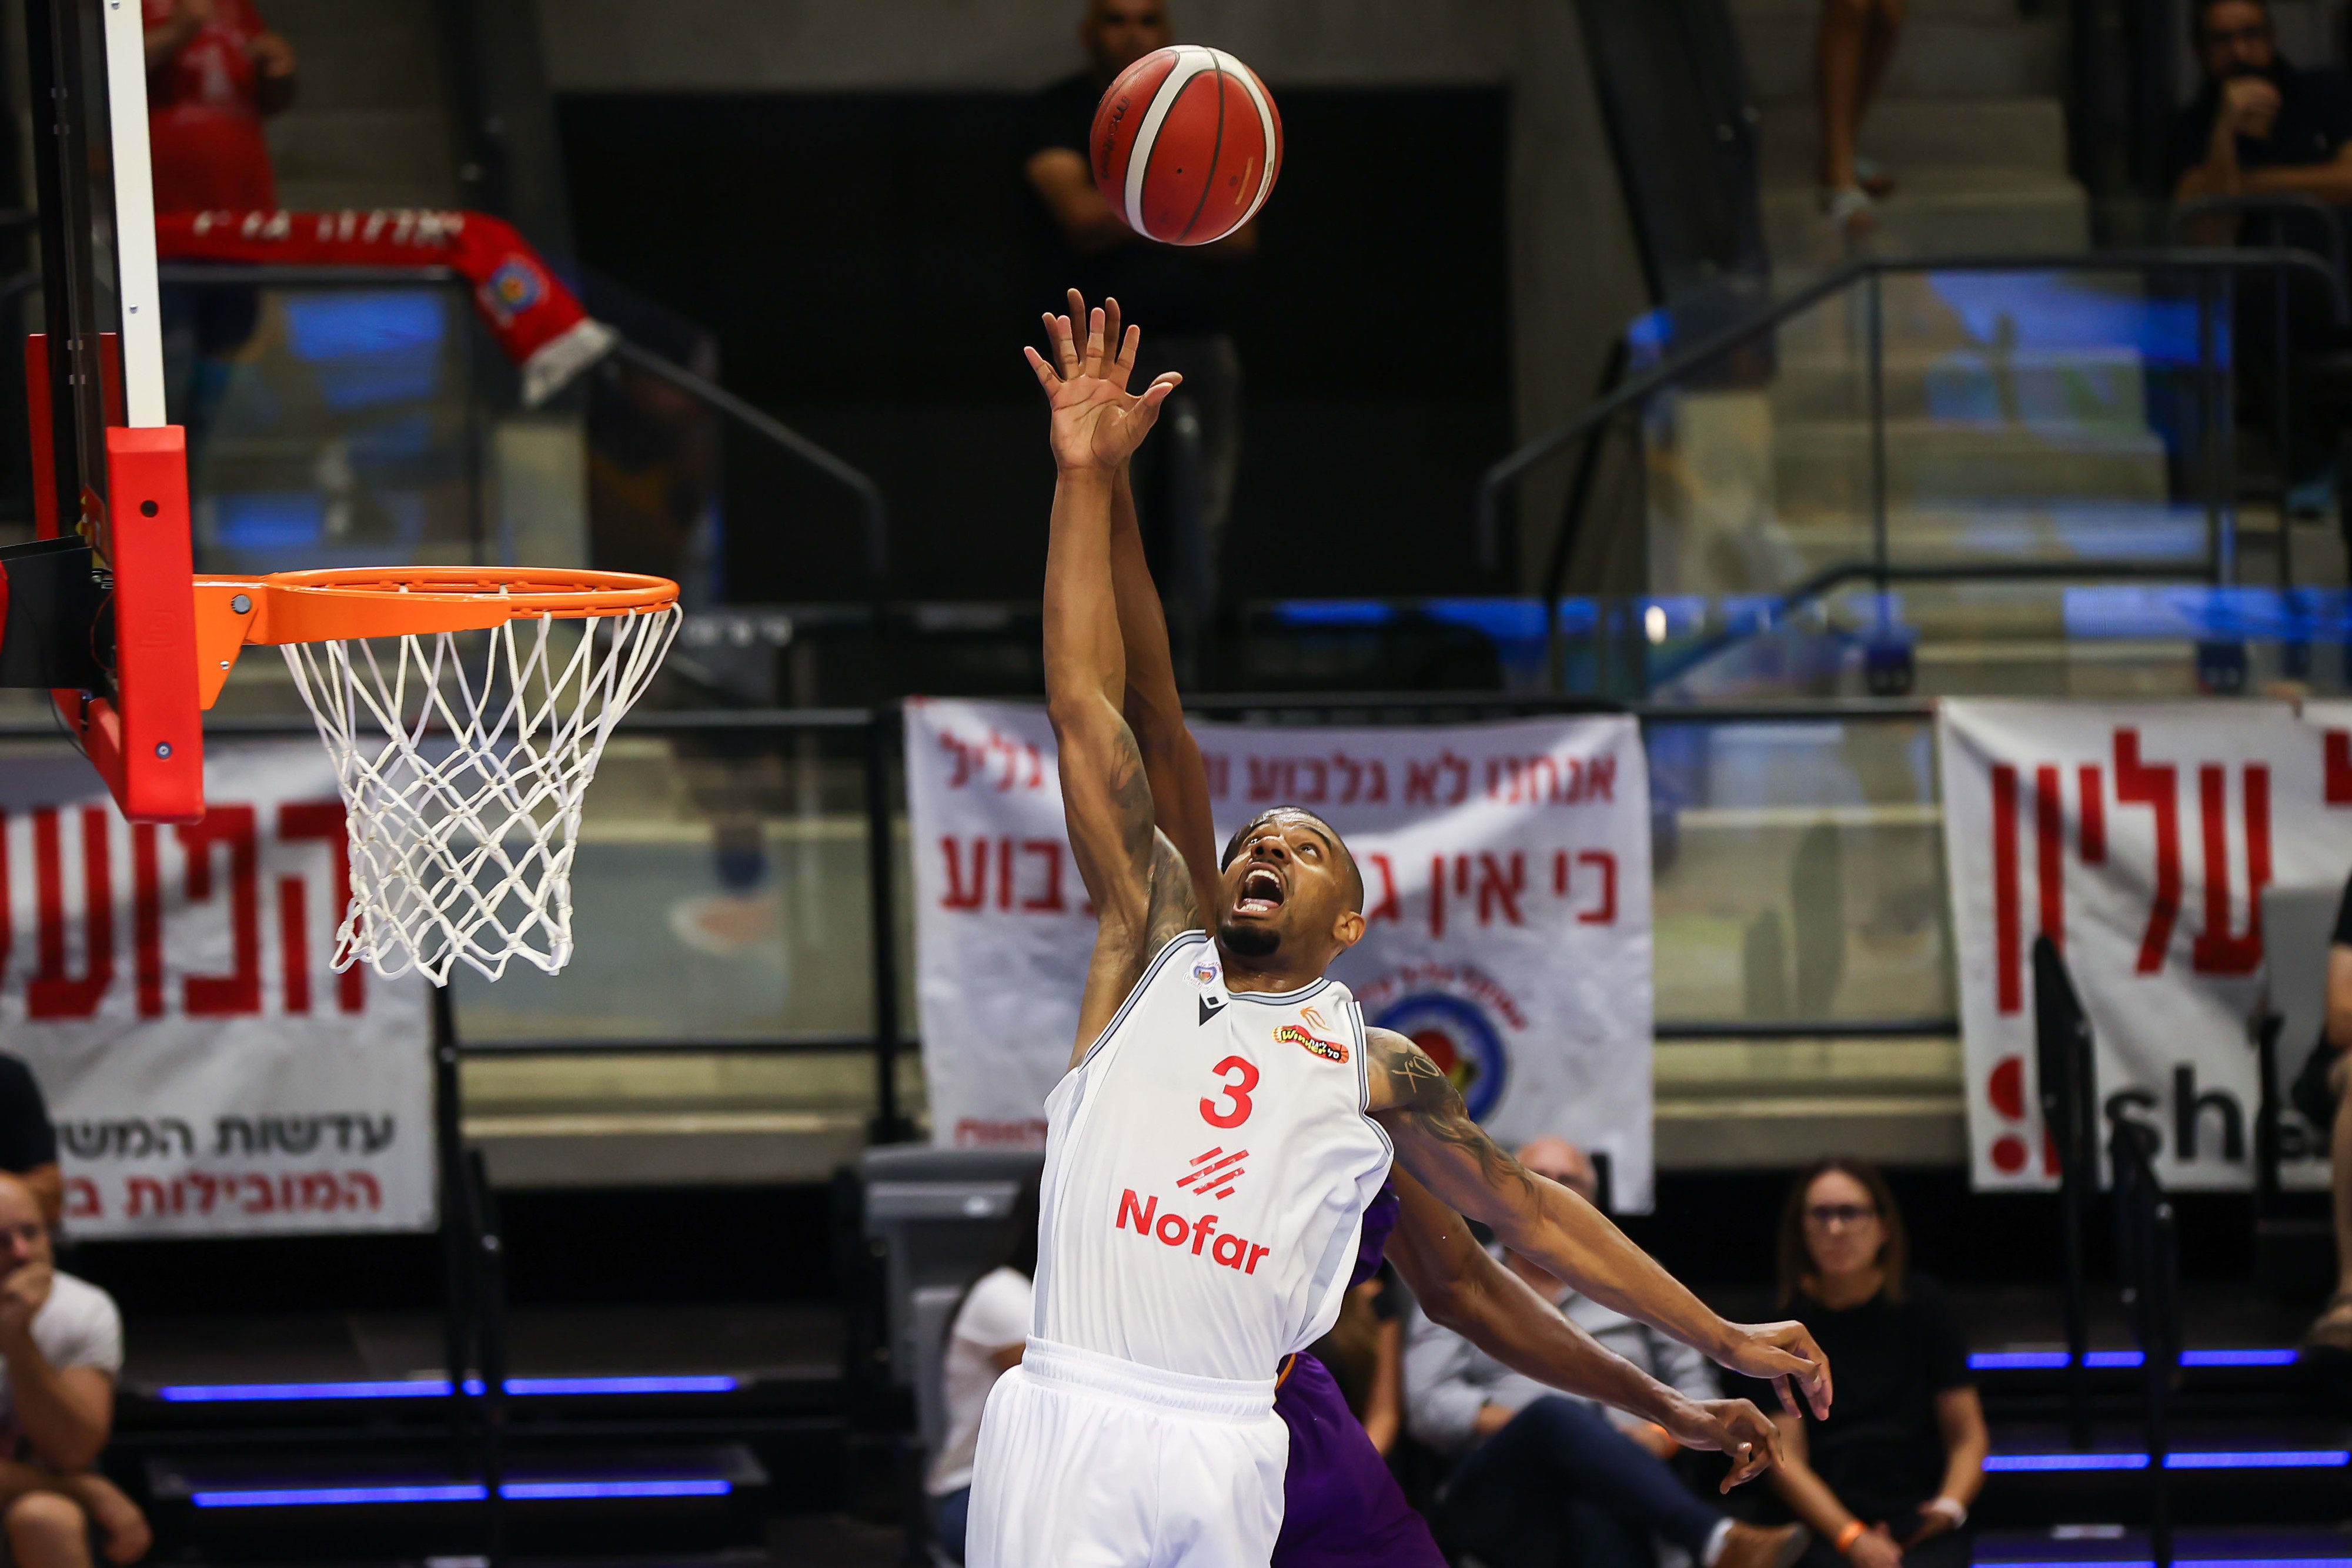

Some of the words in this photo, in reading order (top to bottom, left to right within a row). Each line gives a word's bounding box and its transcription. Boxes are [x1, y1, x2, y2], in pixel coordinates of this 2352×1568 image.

[940, 731, 1044, 791] גליל
[1248, 755, 1388, 802] גלבוע
[1406, 750, 1468, 804] לא
[1486, 753, 1616, 804] אנחנו
[941, 835, 1097, 915] בוע
[1429, 852, 1525, 938] אין
[1553, 849, 1618, 925] כי
[1992, 728, 2273, 1015] עליון
[0, 801, 366, 1020] הפוע
[1281, 1029, 1327, 1055] Winner
[1200, 1055, 1259, 1128] 3
[58, 1116, 192, 1160] המש
[213, 1112, 396, 1155] עדשות
[126, 1173, 382, 1216] המובילות
[1115, 1188, 1270, 1275] Nofar
